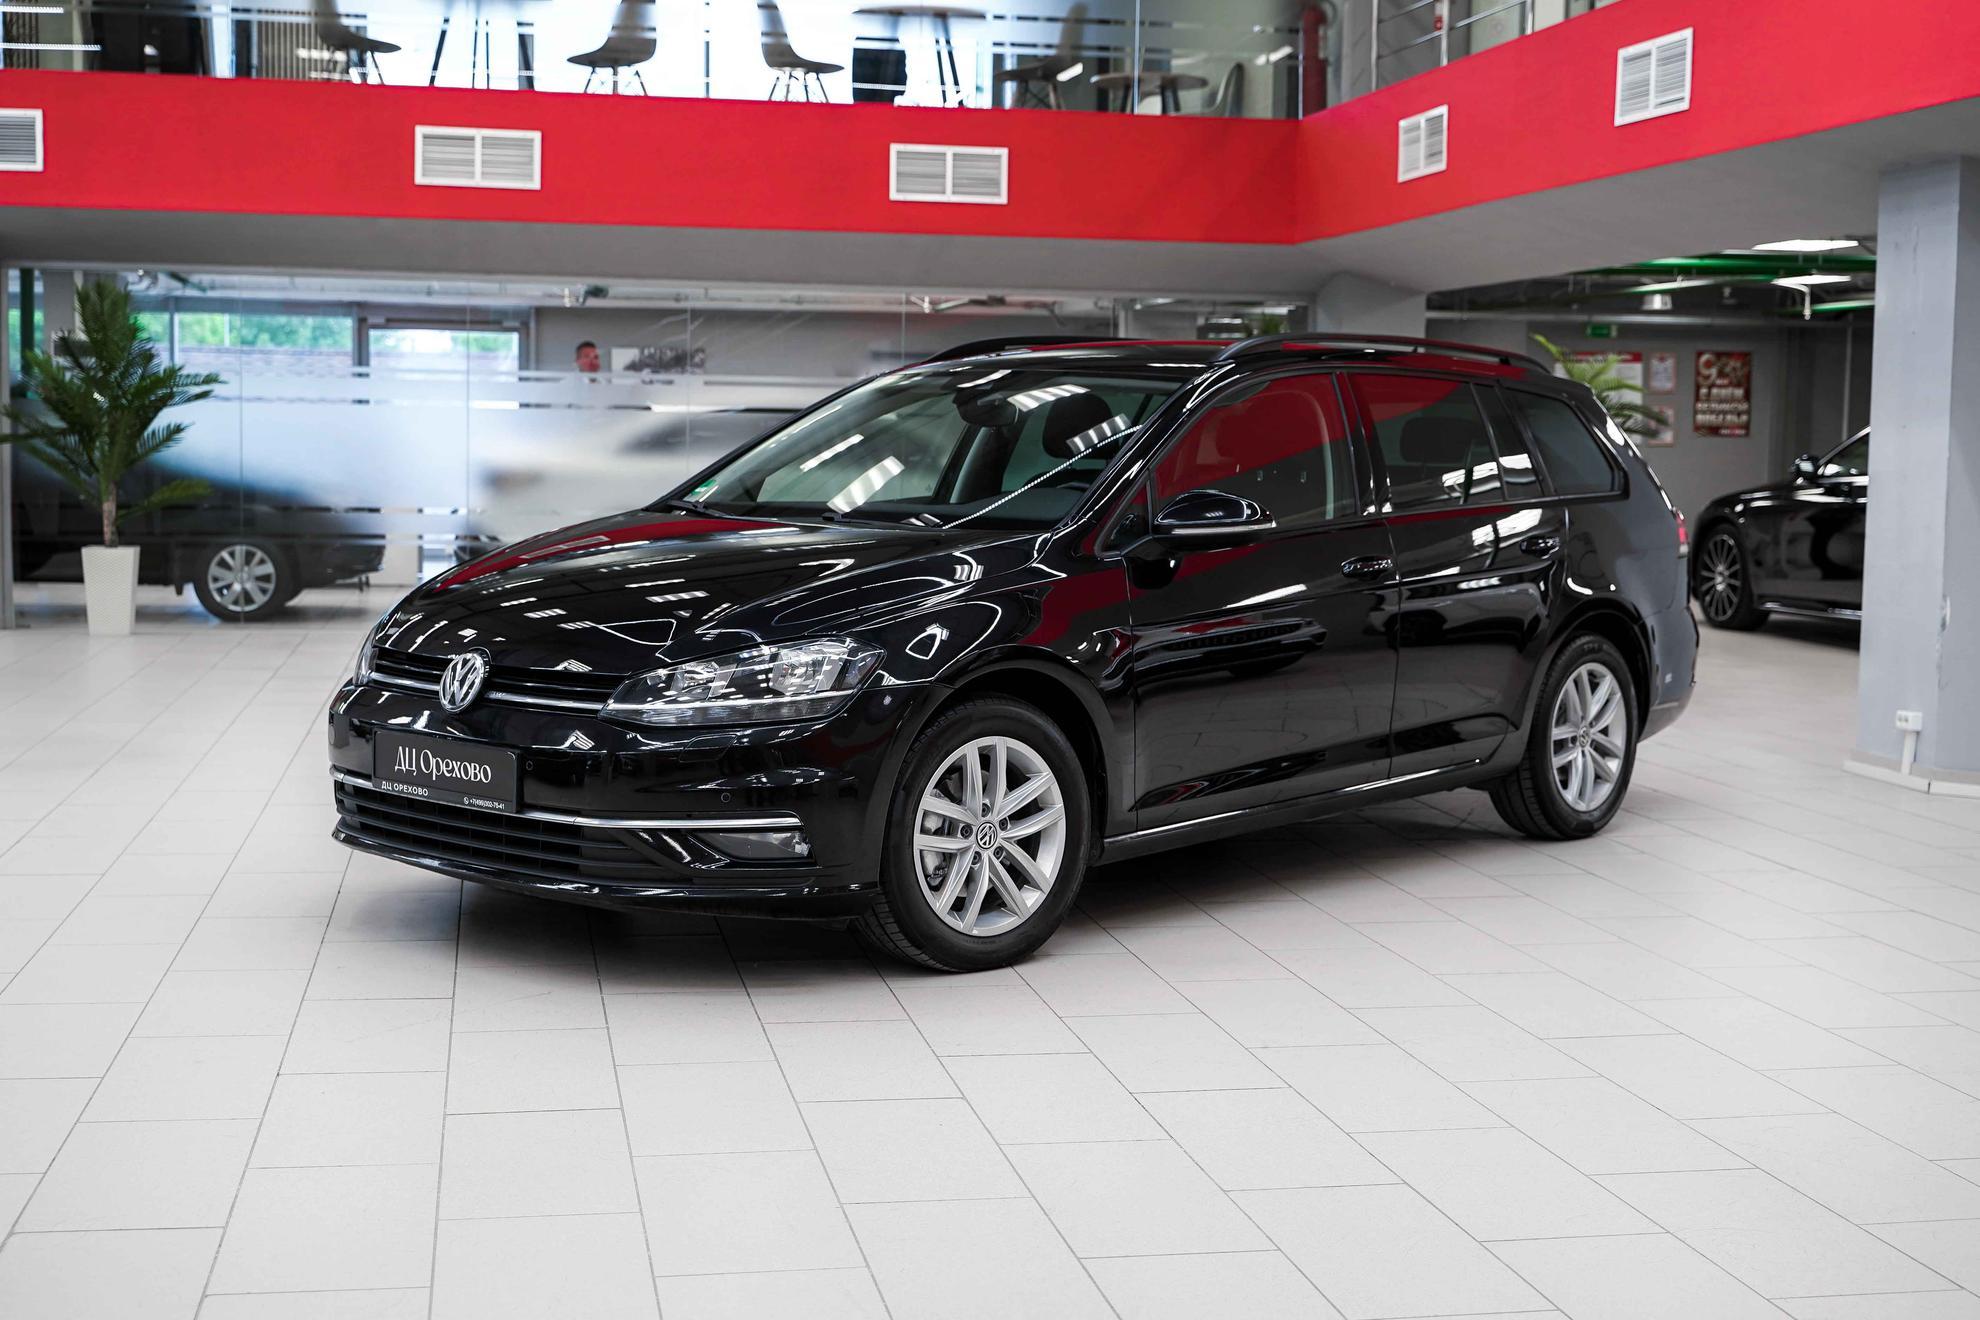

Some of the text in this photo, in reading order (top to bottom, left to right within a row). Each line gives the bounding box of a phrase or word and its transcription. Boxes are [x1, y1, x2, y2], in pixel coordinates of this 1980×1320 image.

[394, 746, 492, 783] ДЦ Орехово
[381, 781, 429, 796] ДЦ ОРЕХОВО
